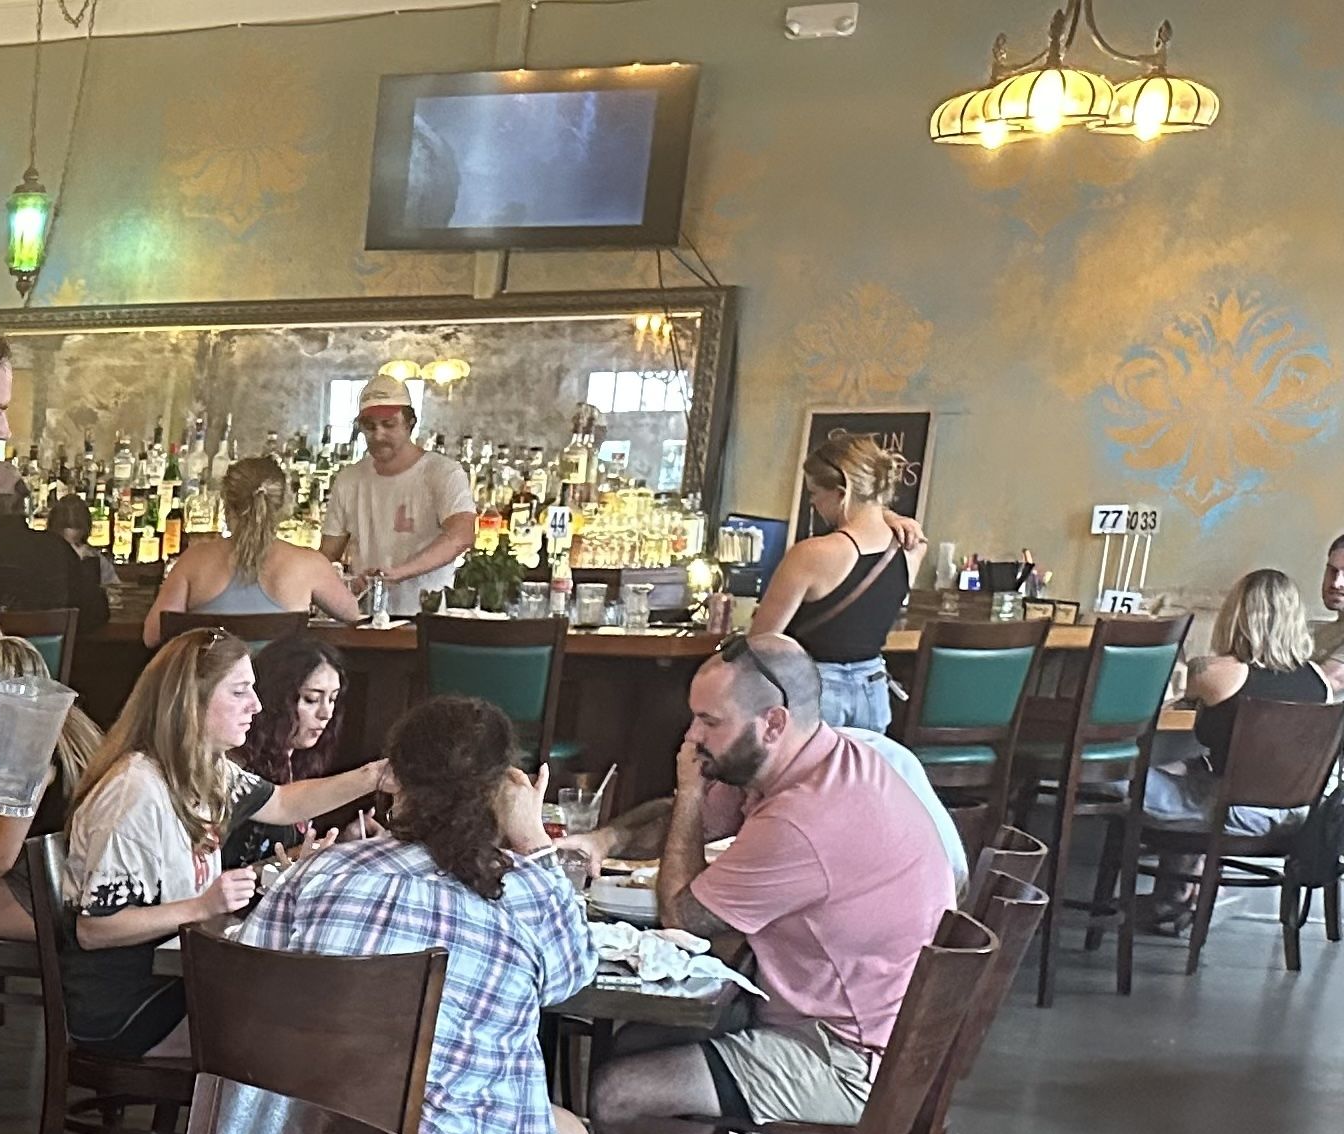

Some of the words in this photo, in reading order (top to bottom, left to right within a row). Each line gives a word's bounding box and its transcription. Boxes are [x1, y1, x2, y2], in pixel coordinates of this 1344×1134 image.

[551, 512, 565, 532] 44
[1099, 511, 1123, 529] 77
[1140, 511, 1157, 530] 33
[1111, 597, 1134, 613] 15
